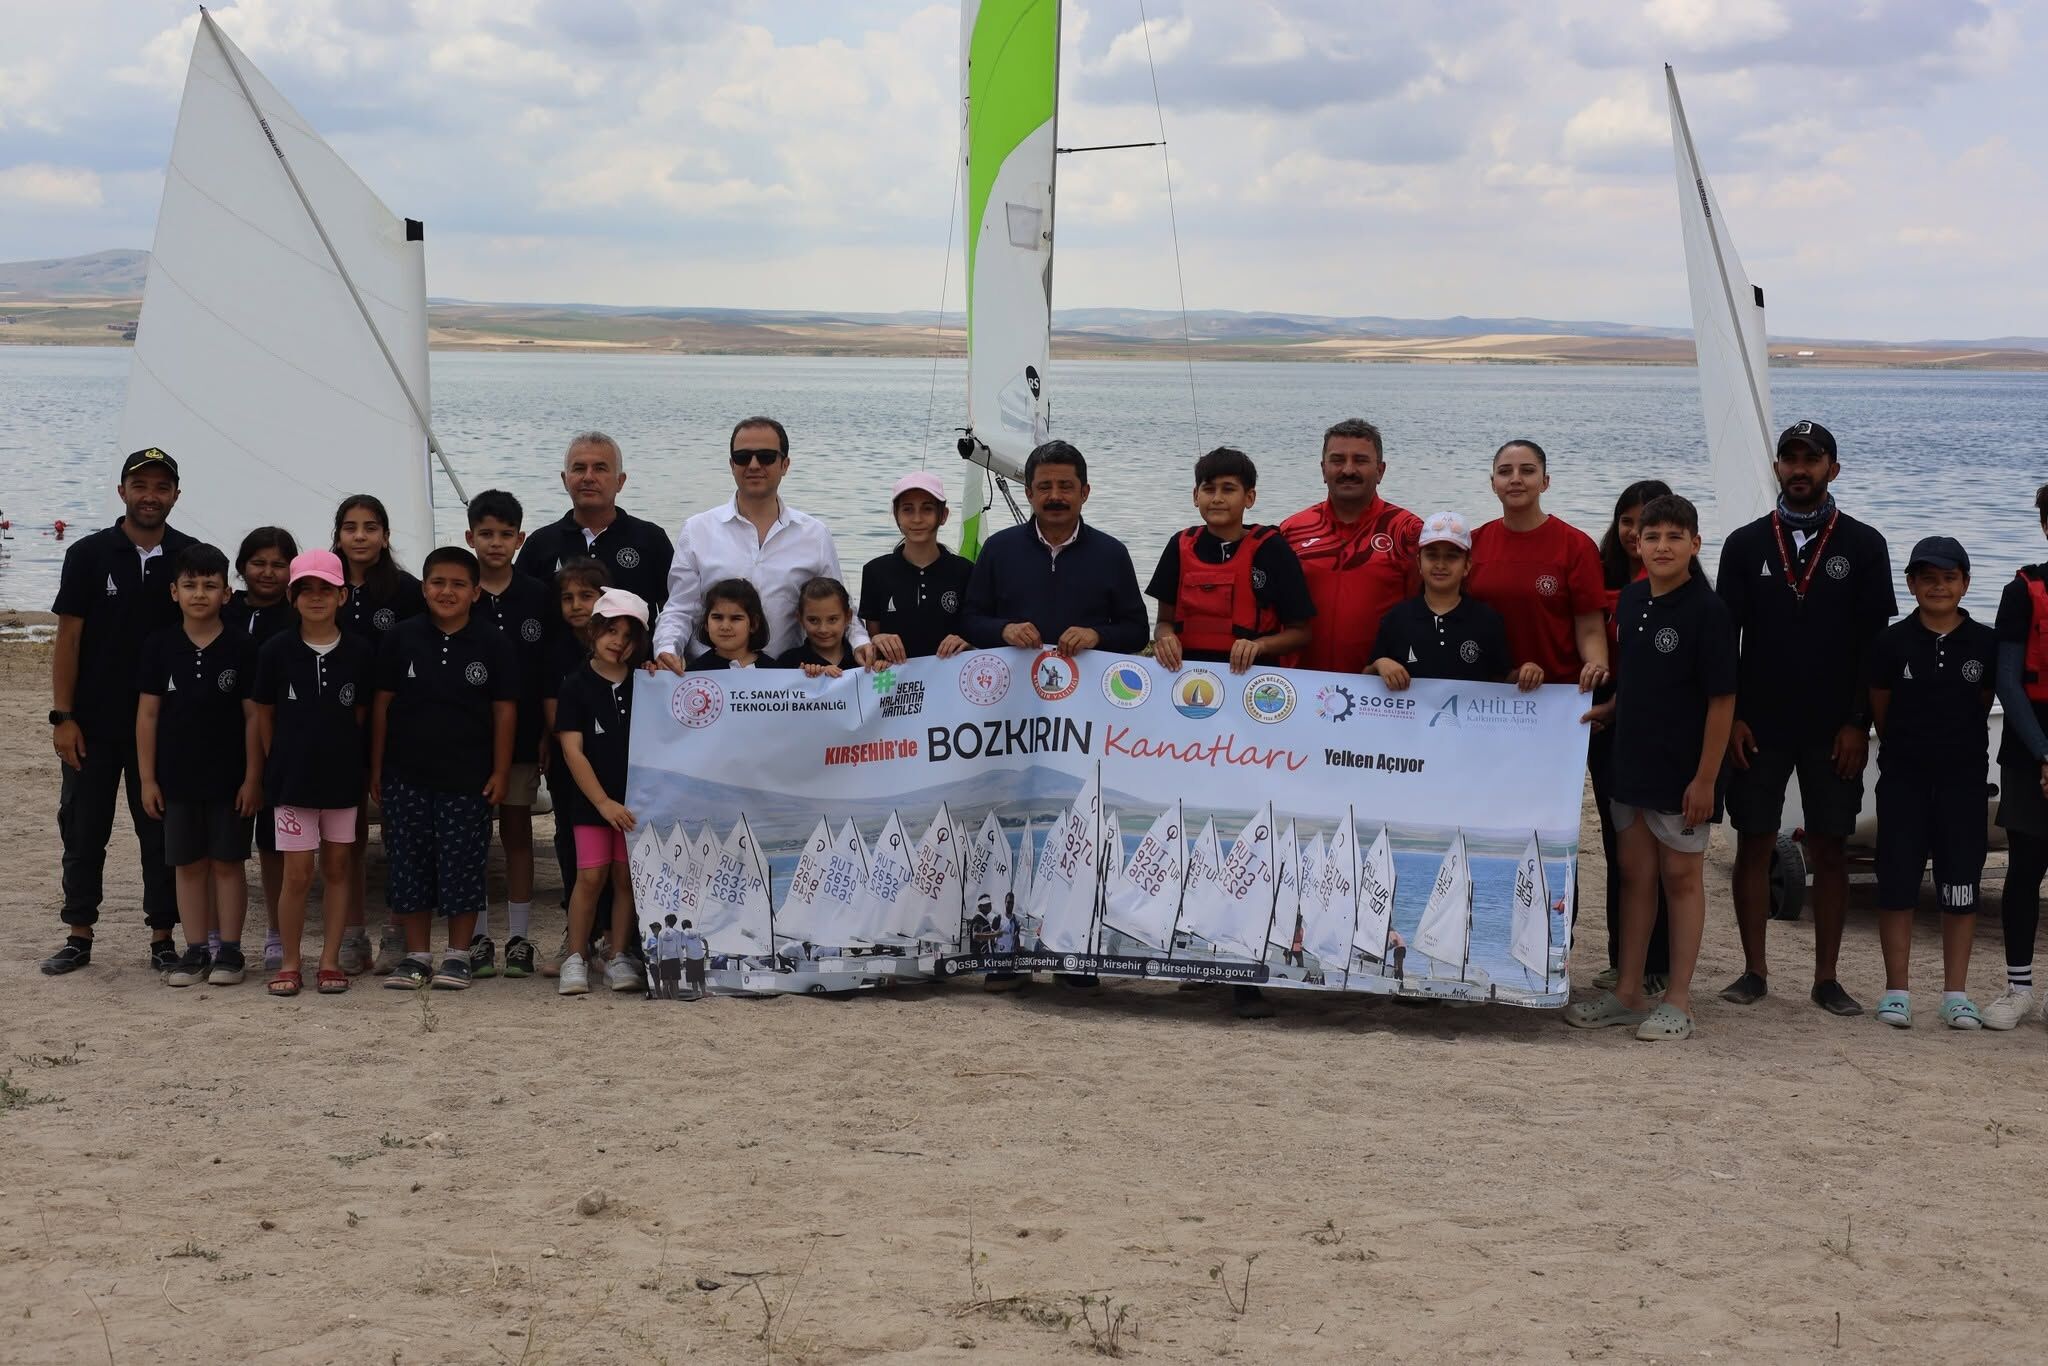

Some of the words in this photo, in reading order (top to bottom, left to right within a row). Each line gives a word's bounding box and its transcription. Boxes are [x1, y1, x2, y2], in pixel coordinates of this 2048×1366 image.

[1028, 377, 1040, 389] RS
[730, 691, 749, 700] T.C.
[751, 689, 790, 700] SANAYİ
[792, 691, 806, 699] VE
[896, 680, 925, 694] YEREL
[730, 701, 789, 712] TEKNOLOJİ
[792, 700, 847, 711] BAKANLIĞI
[1360, 695, 1416, 710] SOGEP
[1467, 696, 1537, 716] AHİLER
[824, 738, 918, 767] KIRŞEHİR'de
[927, 716, 1093, 763] BOZKIRIN
[1104, 723, 1309, 771] Kanatları
[1324, 748, 1374, 770] Yelken
[1376, 752, 1425, 774] Açıyor
[1951, 883, 1974, 907] NBA
[1078, 957, 1142, 971] gsb_kirsehir
[1161, 962, 1256, 978] kirsehir.gsb.gov.tr
